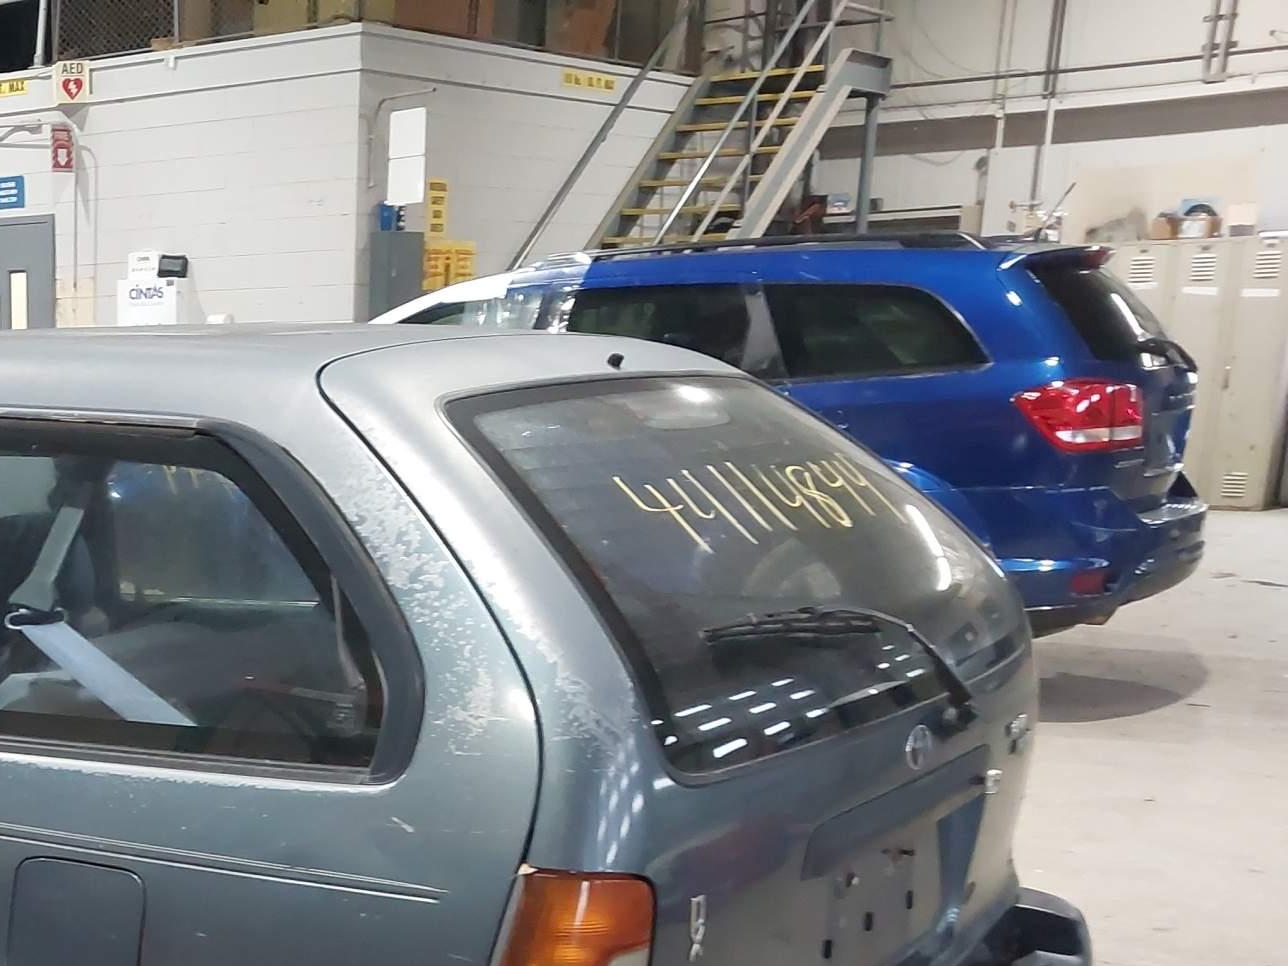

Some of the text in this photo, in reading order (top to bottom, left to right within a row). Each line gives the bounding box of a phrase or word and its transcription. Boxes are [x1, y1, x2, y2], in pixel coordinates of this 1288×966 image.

[62, 62, 84, 74] AED
[8, 80, 25, 93] MAX
[612, 452, 909, 554] 44114844
